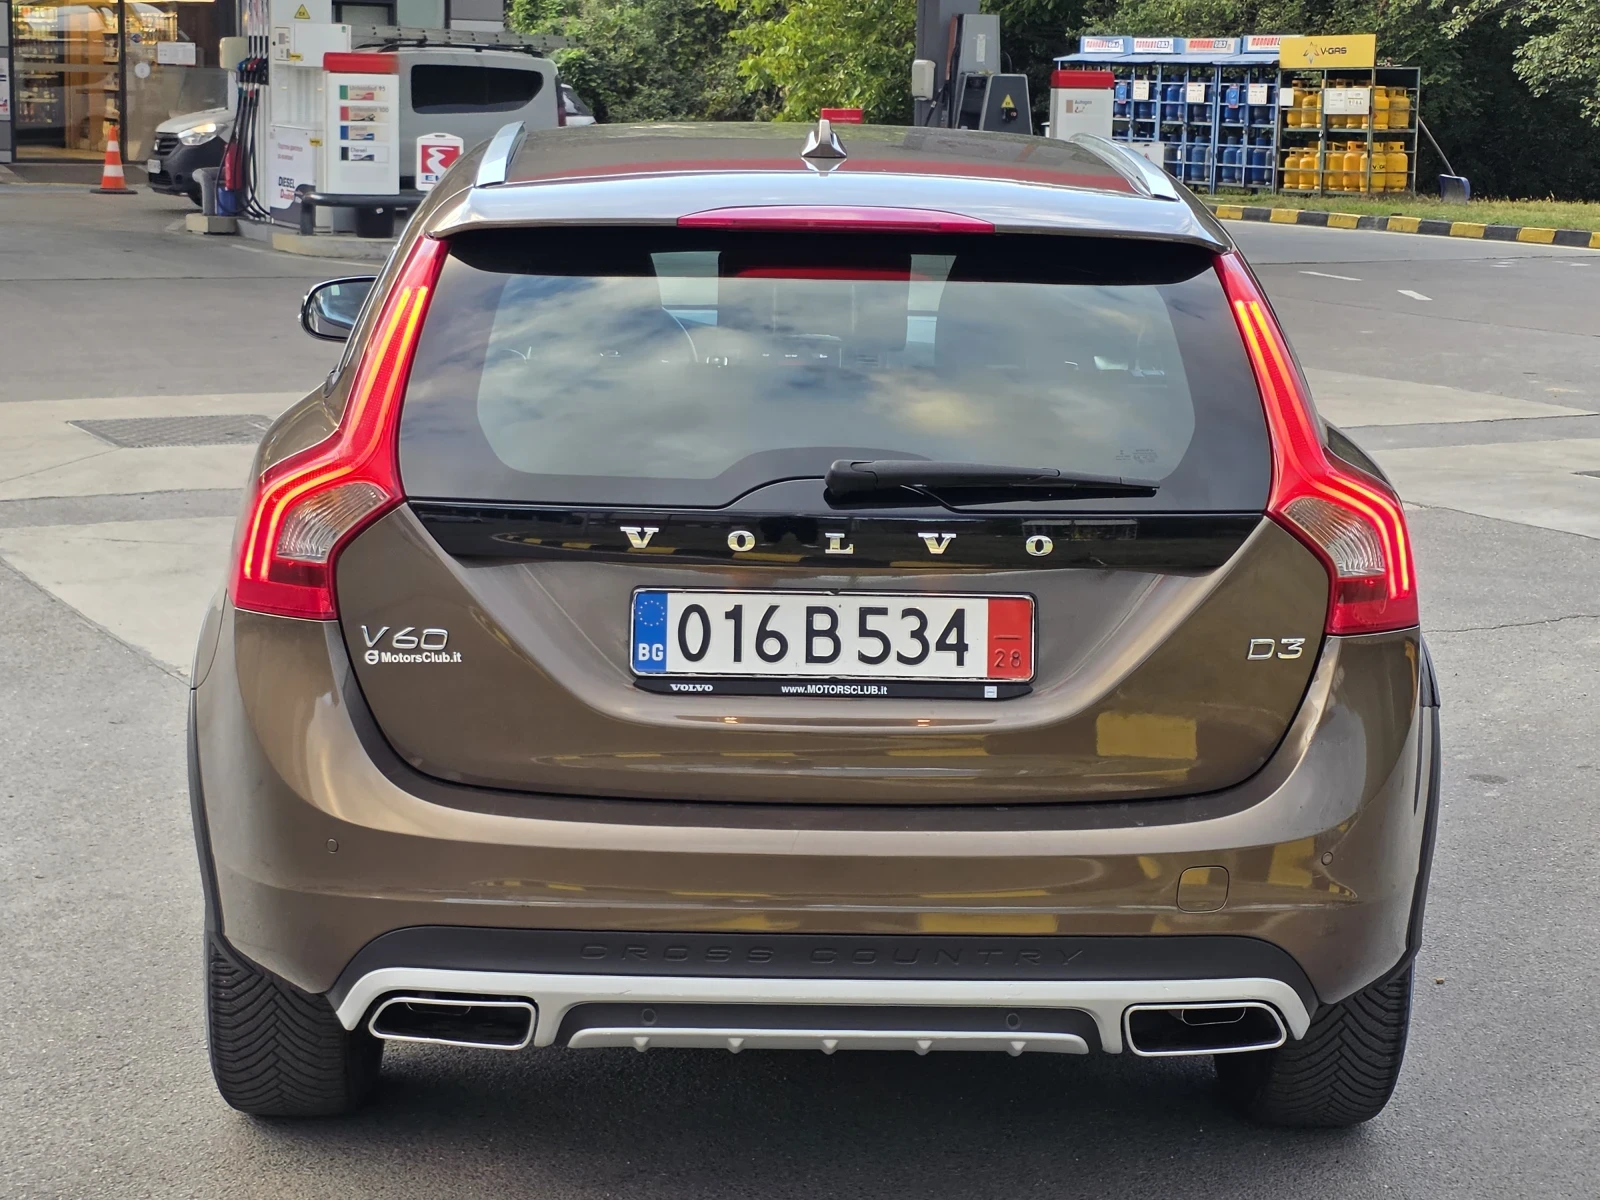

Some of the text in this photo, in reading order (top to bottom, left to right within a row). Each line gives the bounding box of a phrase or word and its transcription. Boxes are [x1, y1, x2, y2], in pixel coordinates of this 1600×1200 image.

[1320, 47, 1347, 55] V-GAS
[278, 175, 295, 189] DIESEL
[619, 525, 1054, 558] VOLVO
[360, 624, 449, 651] V60
[380, 651, 463, 664] MotorsClub.it
[637, 642, 665, 662] BG
[993, 648, 1023, 669] 28
[1246, 637, 1307, 661] D3
[669, 683, 714, 692] VOLVO
[781, 684, 888, 695] www.MOTORSCLUB.it
[579, 942, 1085, 967] CROSS COUNTRY
